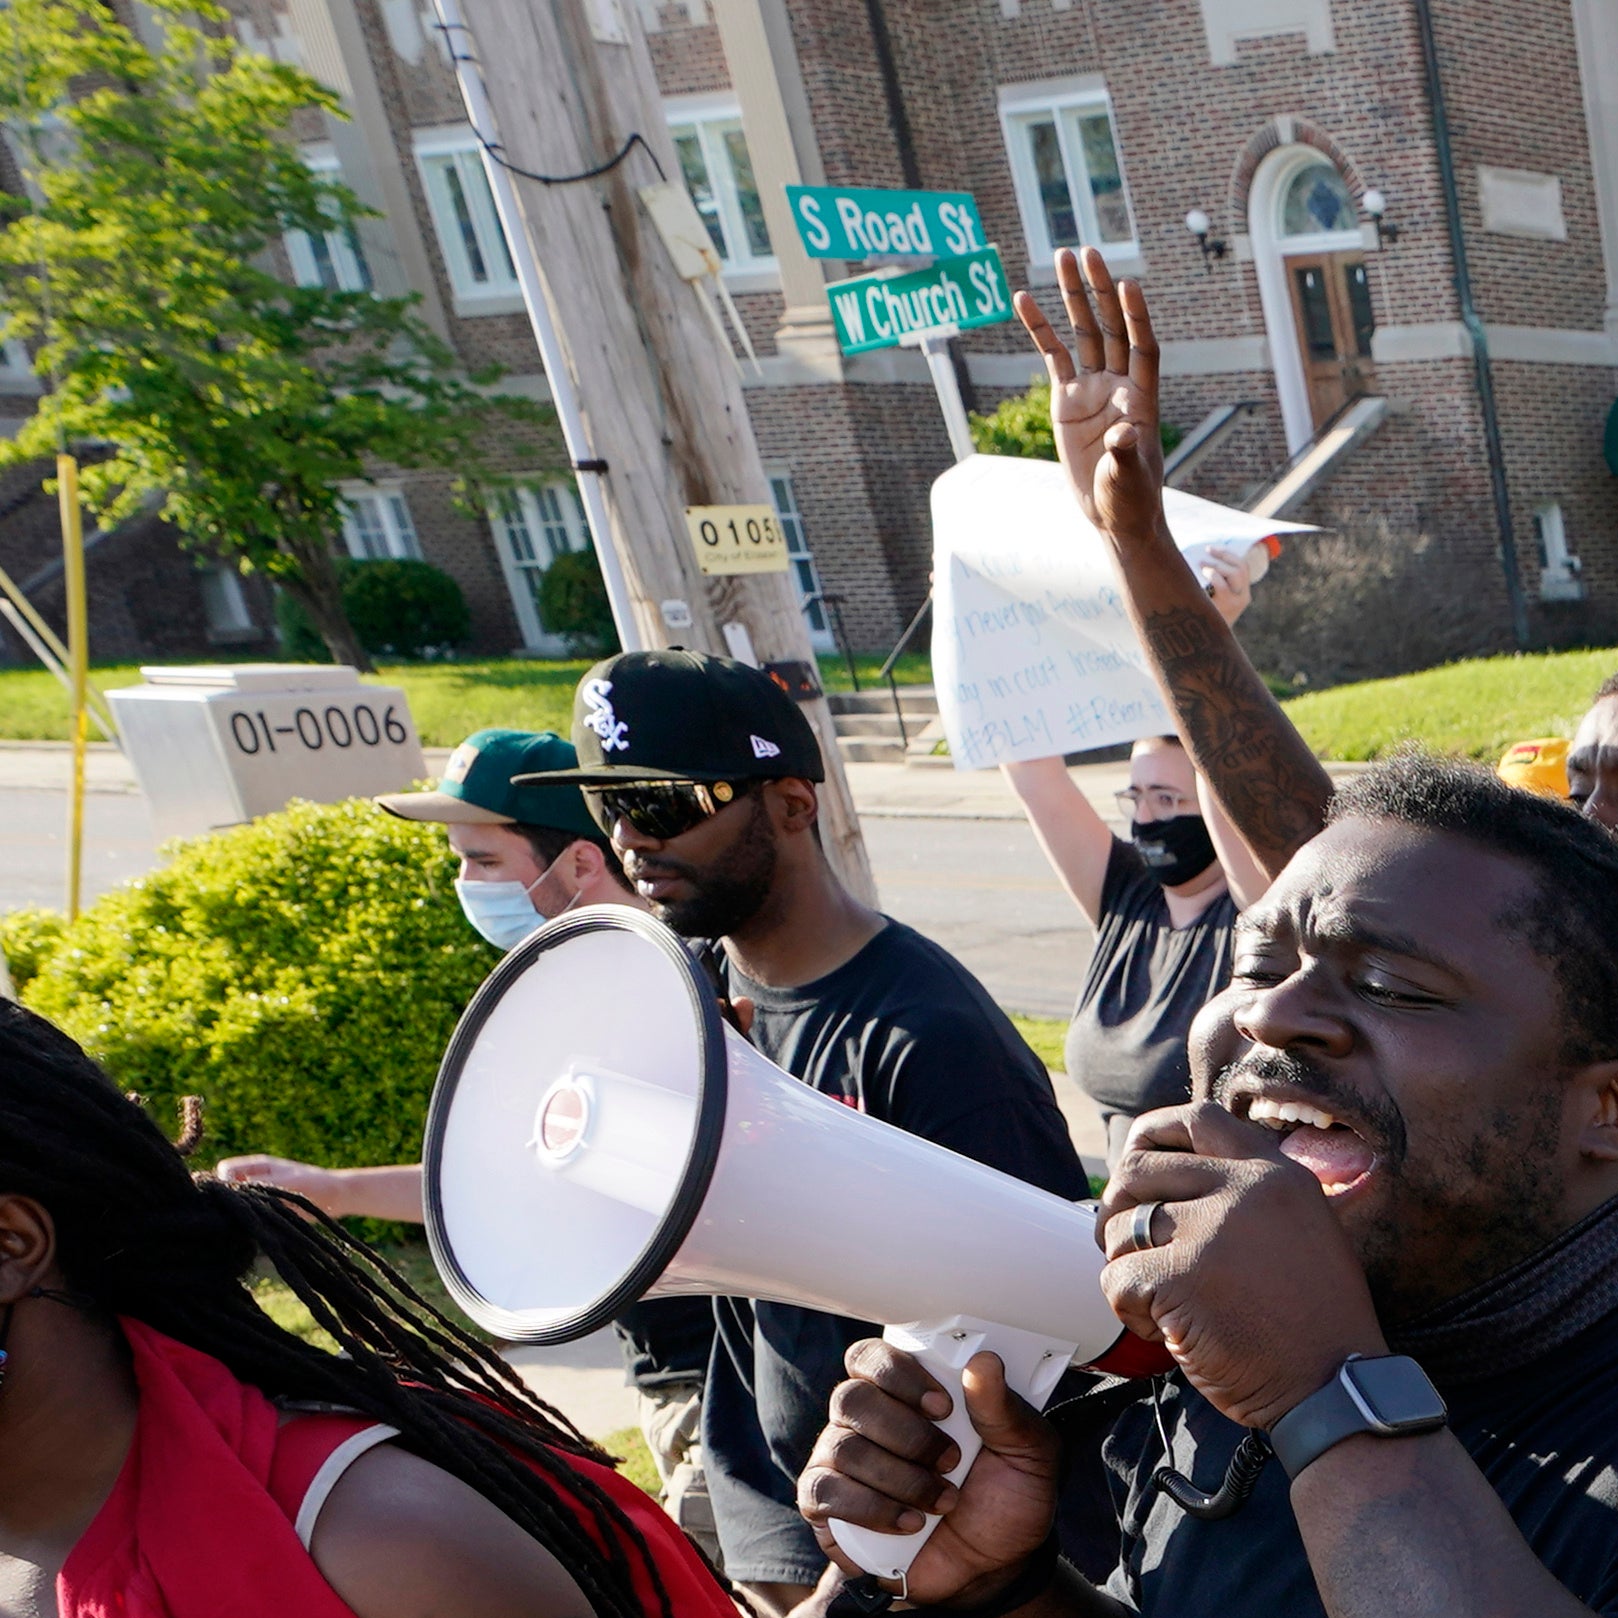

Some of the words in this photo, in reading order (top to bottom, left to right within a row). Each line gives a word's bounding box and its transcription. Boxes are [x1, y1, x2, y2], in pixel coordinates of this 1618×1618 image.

[799, 195, 831, 250] S
[835, 197, 933, 253] Road
[938, 202, 985, 255] St
[834, 291, 866, 345] W
[866, 271, 968, 338] Church
[968, 260, 1006, 315] St
[229, 704, 408, 756] 01-0006
